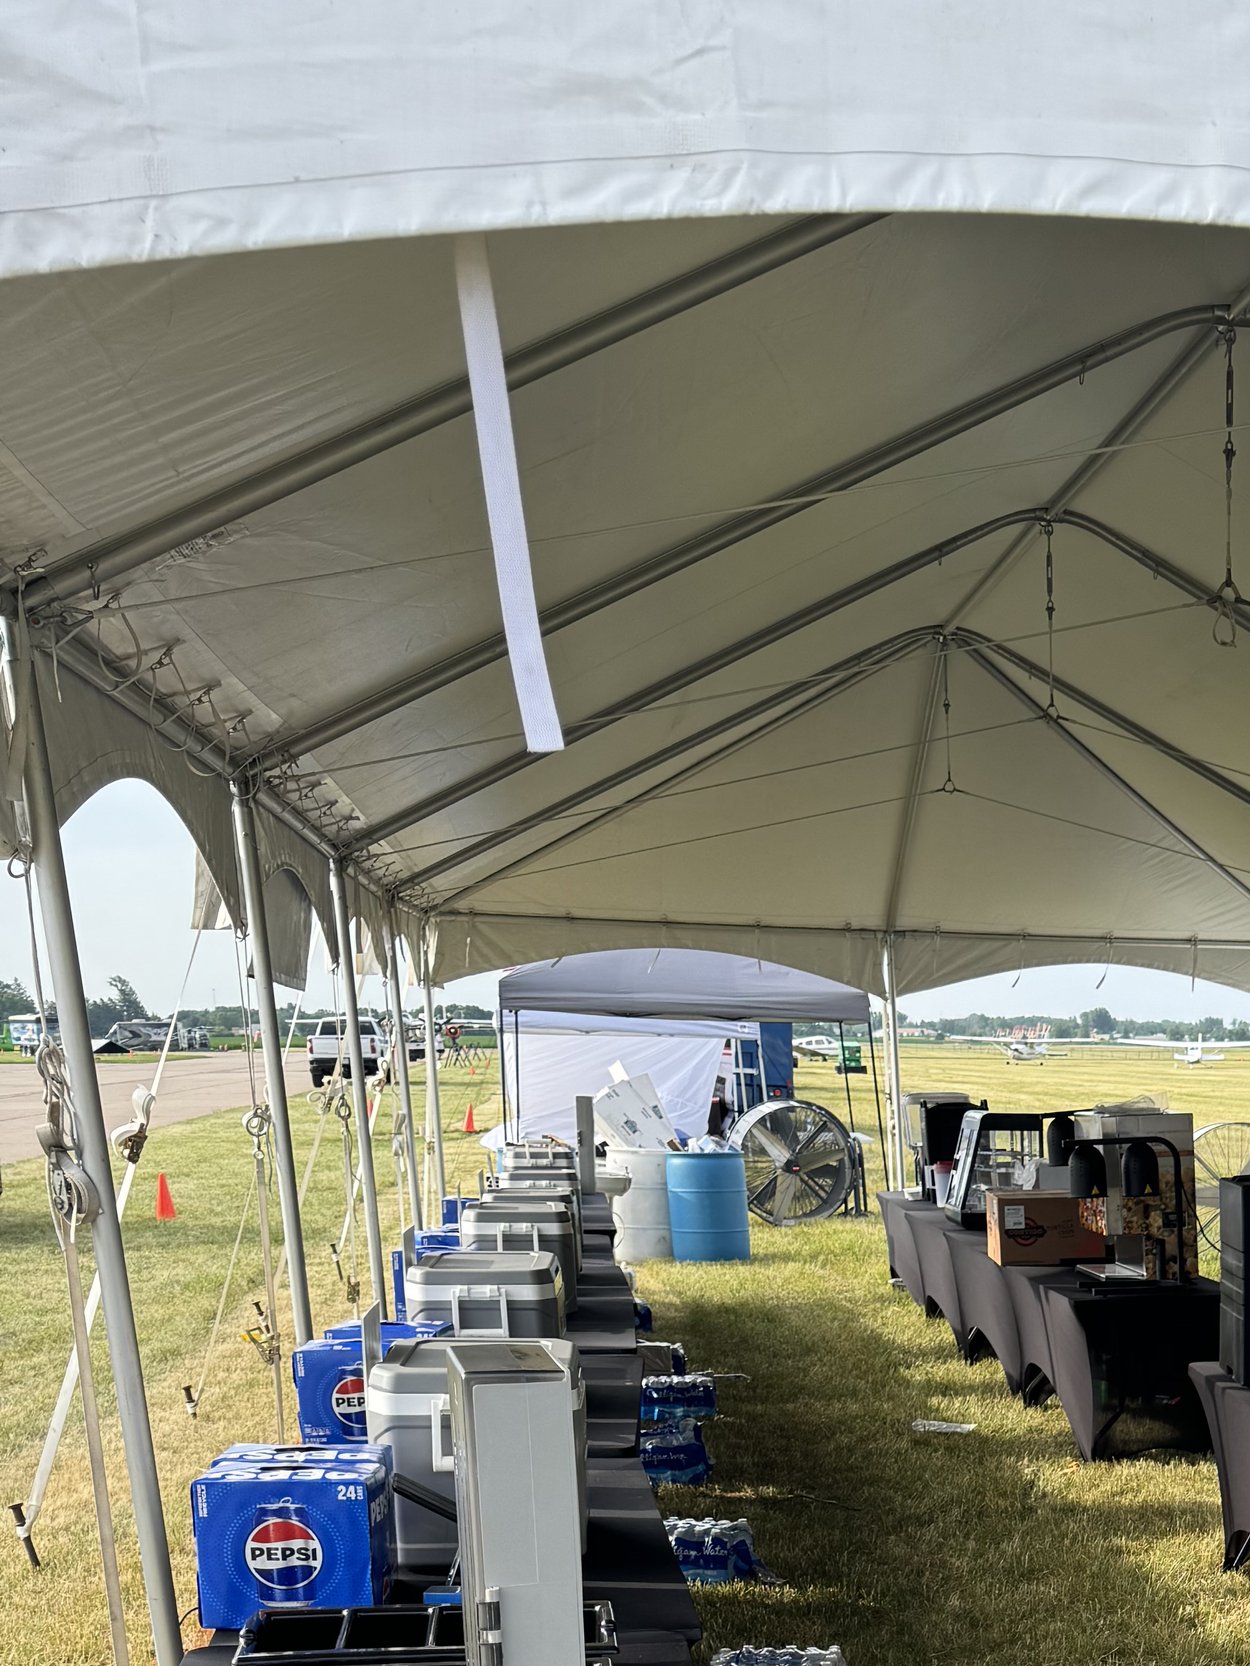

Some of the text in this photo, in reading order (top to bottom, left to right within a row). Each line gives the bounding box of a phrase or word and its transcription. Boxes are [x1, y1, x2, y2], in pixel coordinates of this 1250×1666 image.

[335, 1397, 366, 1408] PEP
[337, 1485, 357, 1500] 24
[251, 1547, 317, 1561] PEPSI
[703, 1544, 728, 1556] Water
